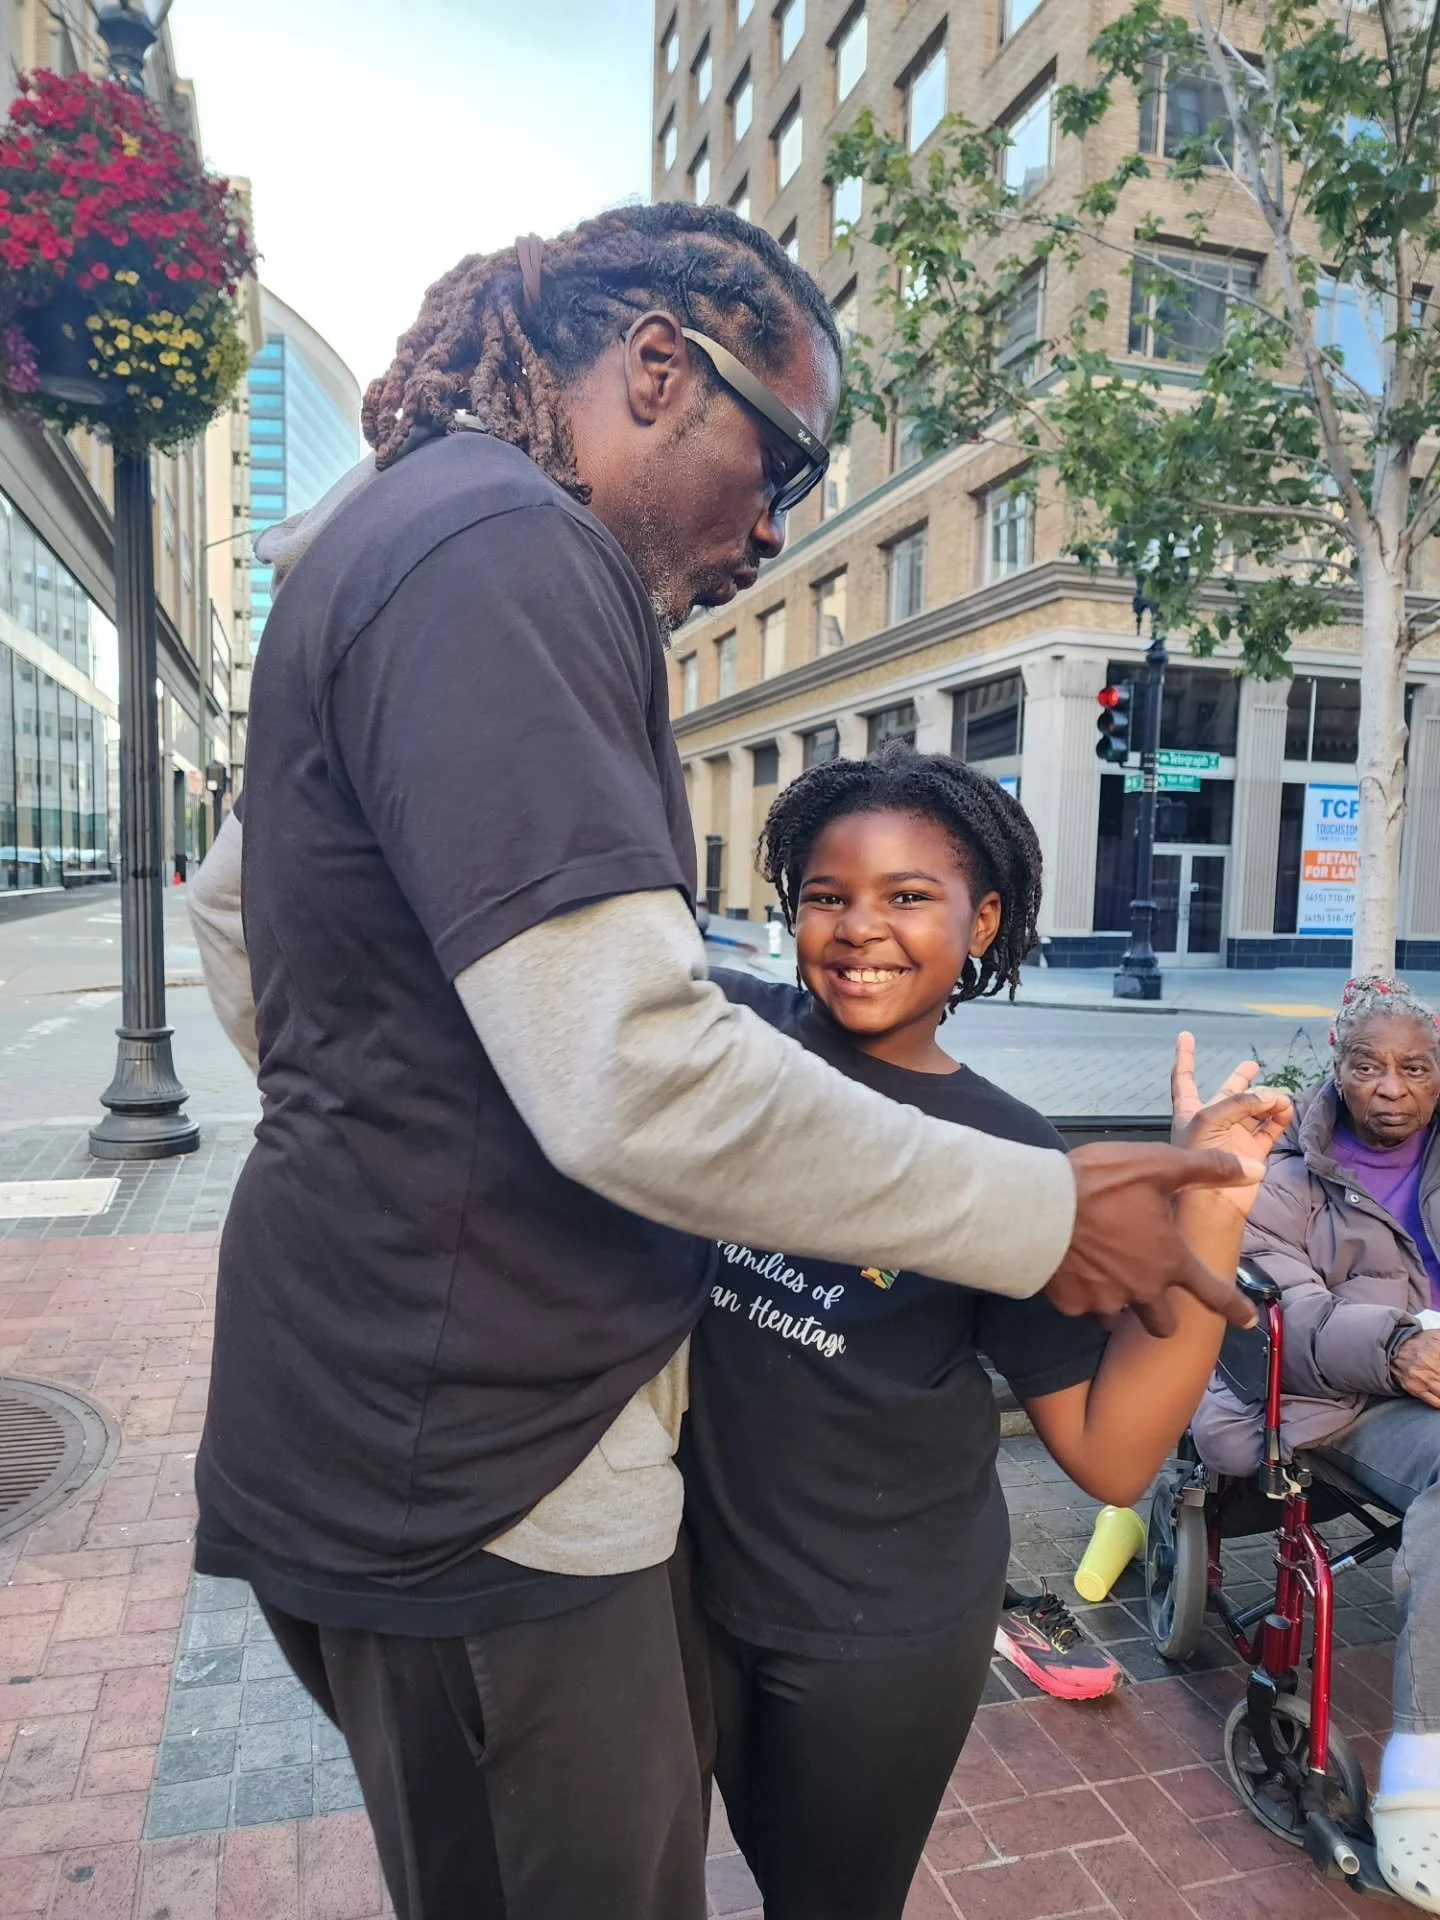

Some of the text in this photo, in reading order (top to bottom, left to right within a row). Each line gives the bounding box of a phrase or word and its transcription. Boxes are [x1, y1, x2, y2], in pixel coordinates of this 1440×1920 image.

[1169, 753, 1209, 768] Telegraph
[1304, 865, 1329, 879] FOR
[811, 1285, 846, 1311] of
[749, 1296, 847, 1358] Heritage
